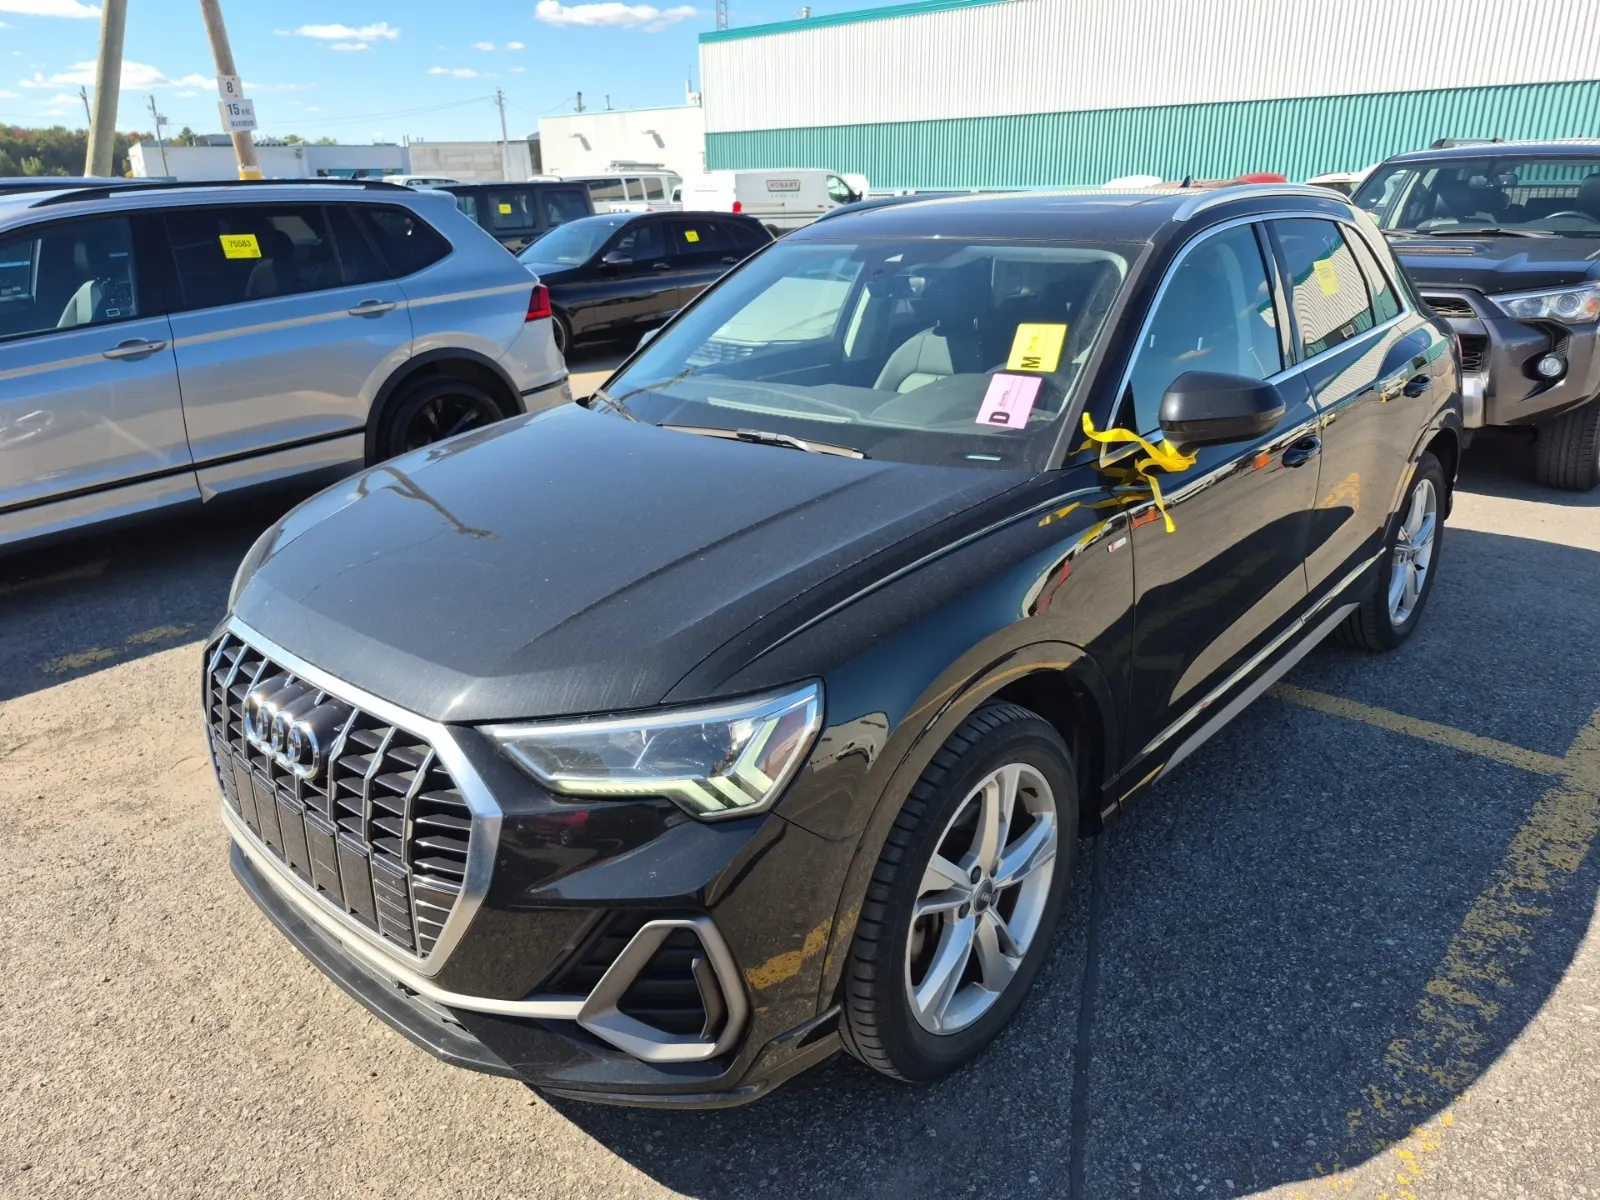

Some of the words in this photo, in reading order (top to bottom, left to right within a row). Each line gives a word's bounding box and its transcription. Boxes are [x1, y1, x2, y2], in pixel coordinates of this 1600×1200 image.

[226, 81, 234, 93] 8
[226, 103, 240, 116] 15
[769, 181, 798, 189] HOBART
[1020, 356, 1042, 369] M
[988, 411, 1011, 425] D
